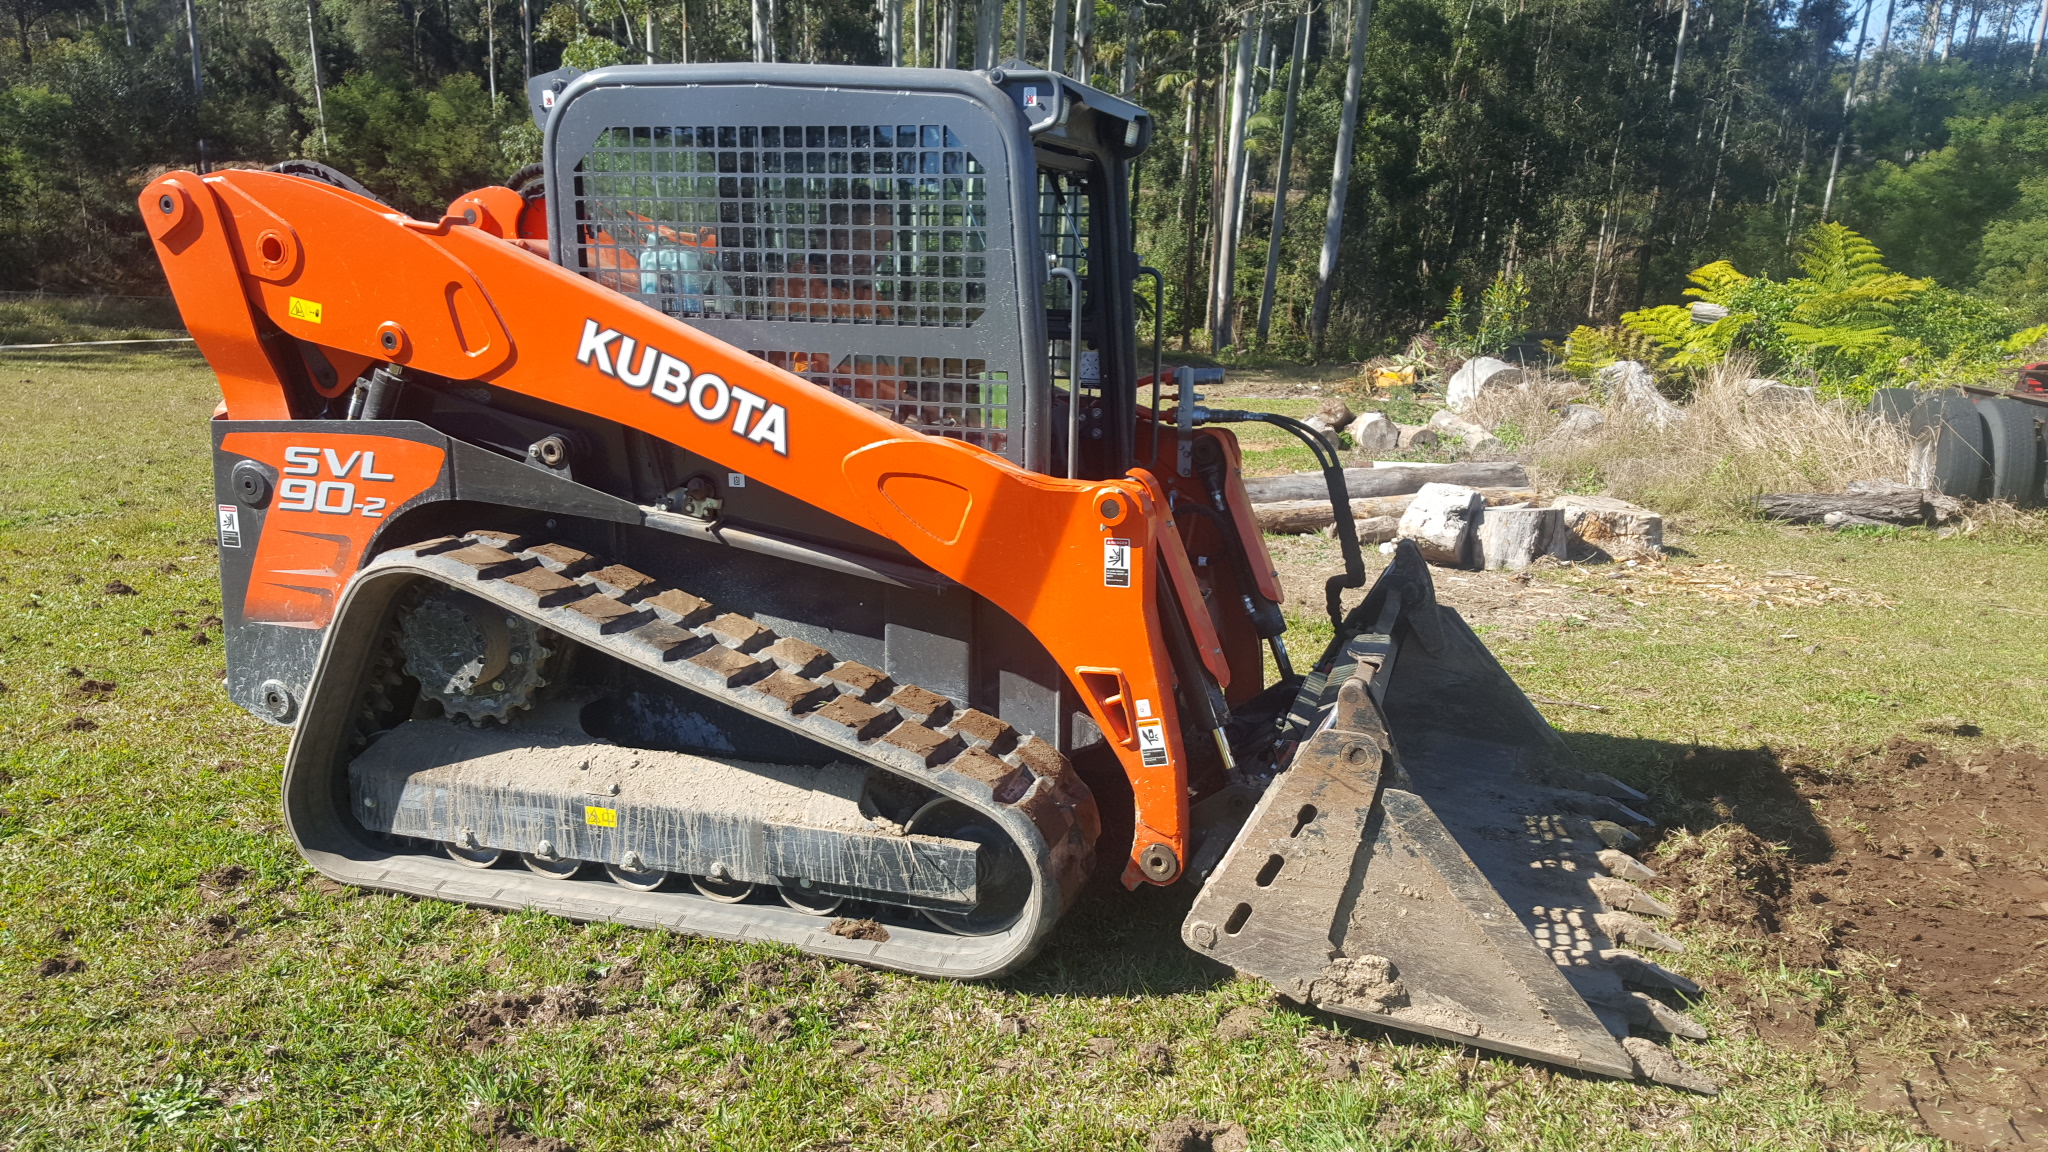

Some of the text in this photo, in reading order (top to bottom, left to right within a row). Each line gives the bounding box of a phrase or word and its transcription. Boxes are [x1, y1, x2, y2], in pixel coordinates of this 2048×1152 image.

[577, 318, 788, 456] KUBOTA
[283, 446, 395, 482] SVL
[278, 478, 386, 518] 90-2
